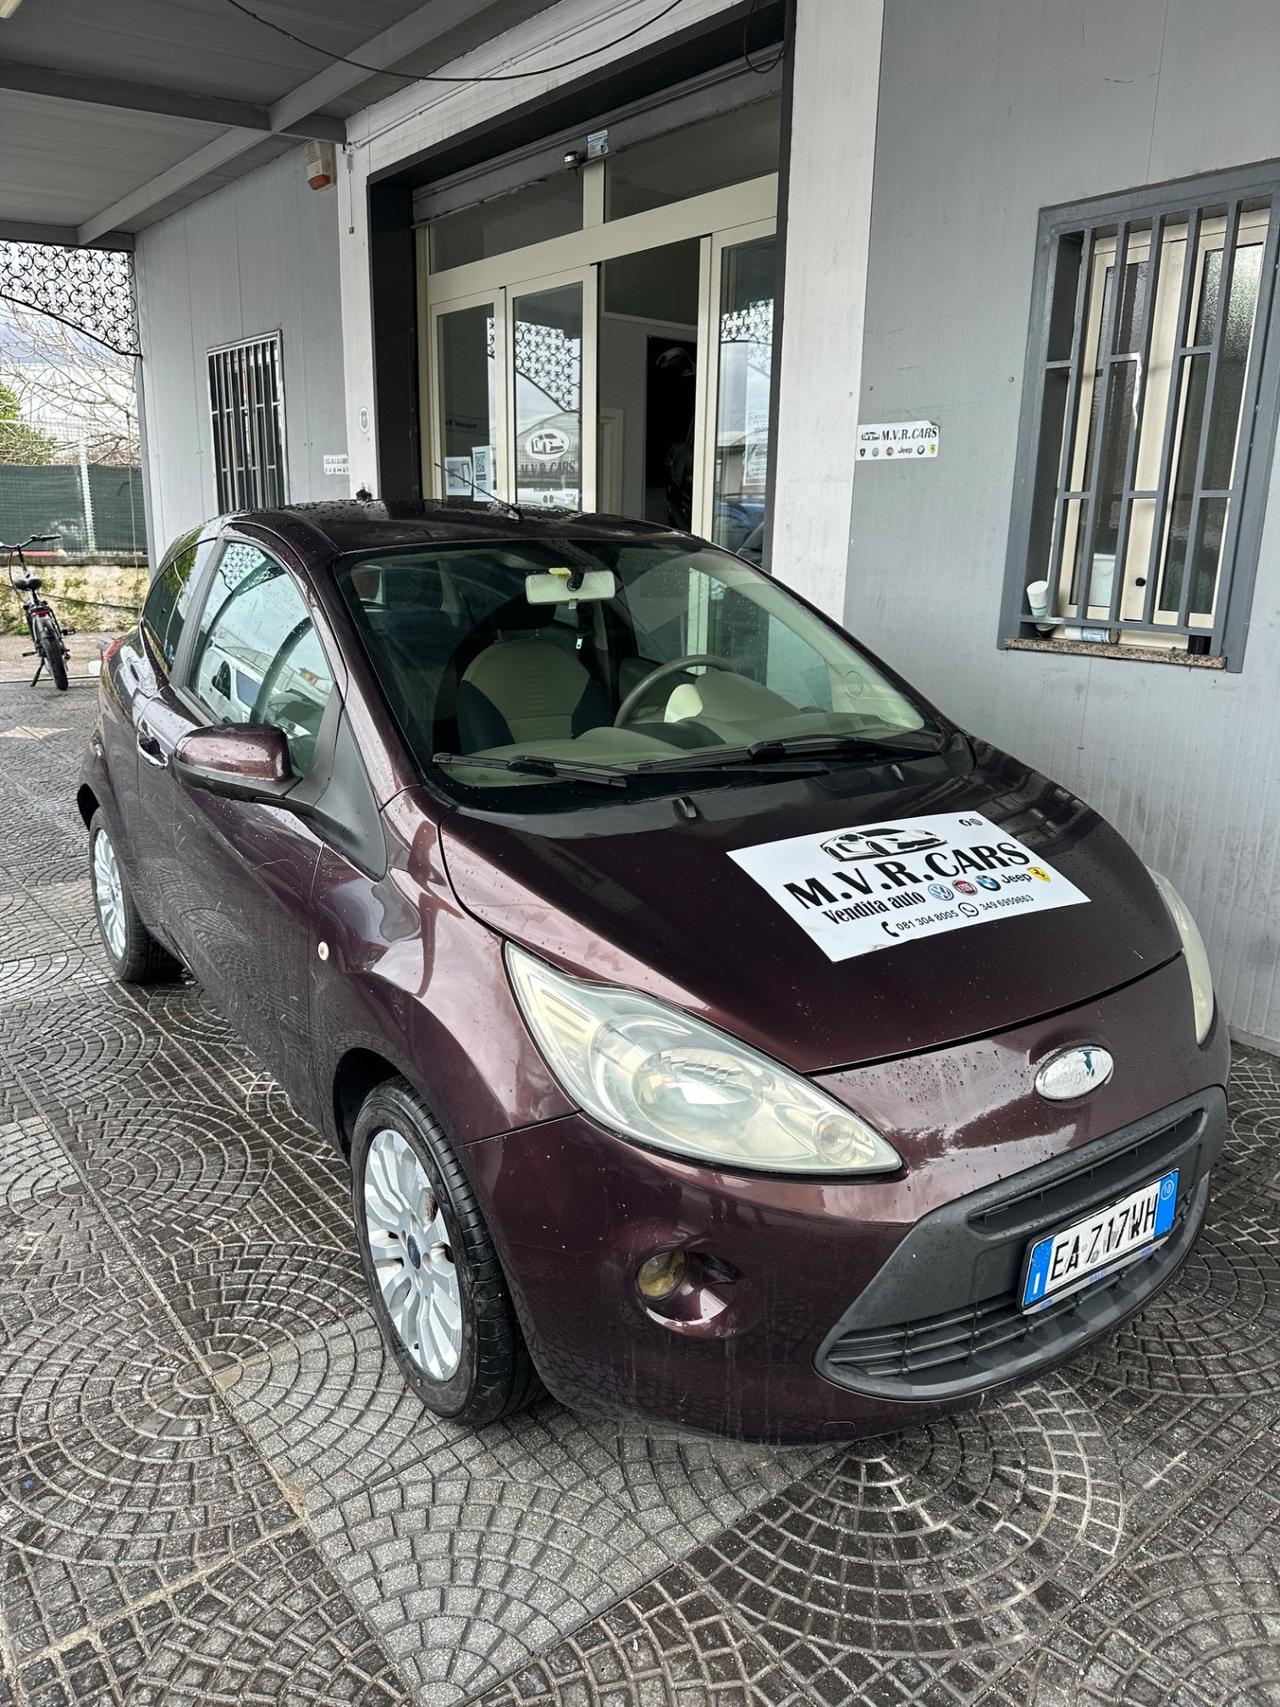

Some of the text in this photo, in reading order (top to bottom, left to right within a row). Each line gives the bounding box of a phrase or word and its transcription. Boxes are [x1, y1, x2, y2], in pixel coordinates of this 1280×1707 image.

[898, 447, 913, 455] Jeep
[1000, 873, 1033, 884] Jeep
[821, 891, 926, 925] Vendita auto
[979, 901, 998, 911] 349
[895, 910, 959, 931] 081 304 8005
